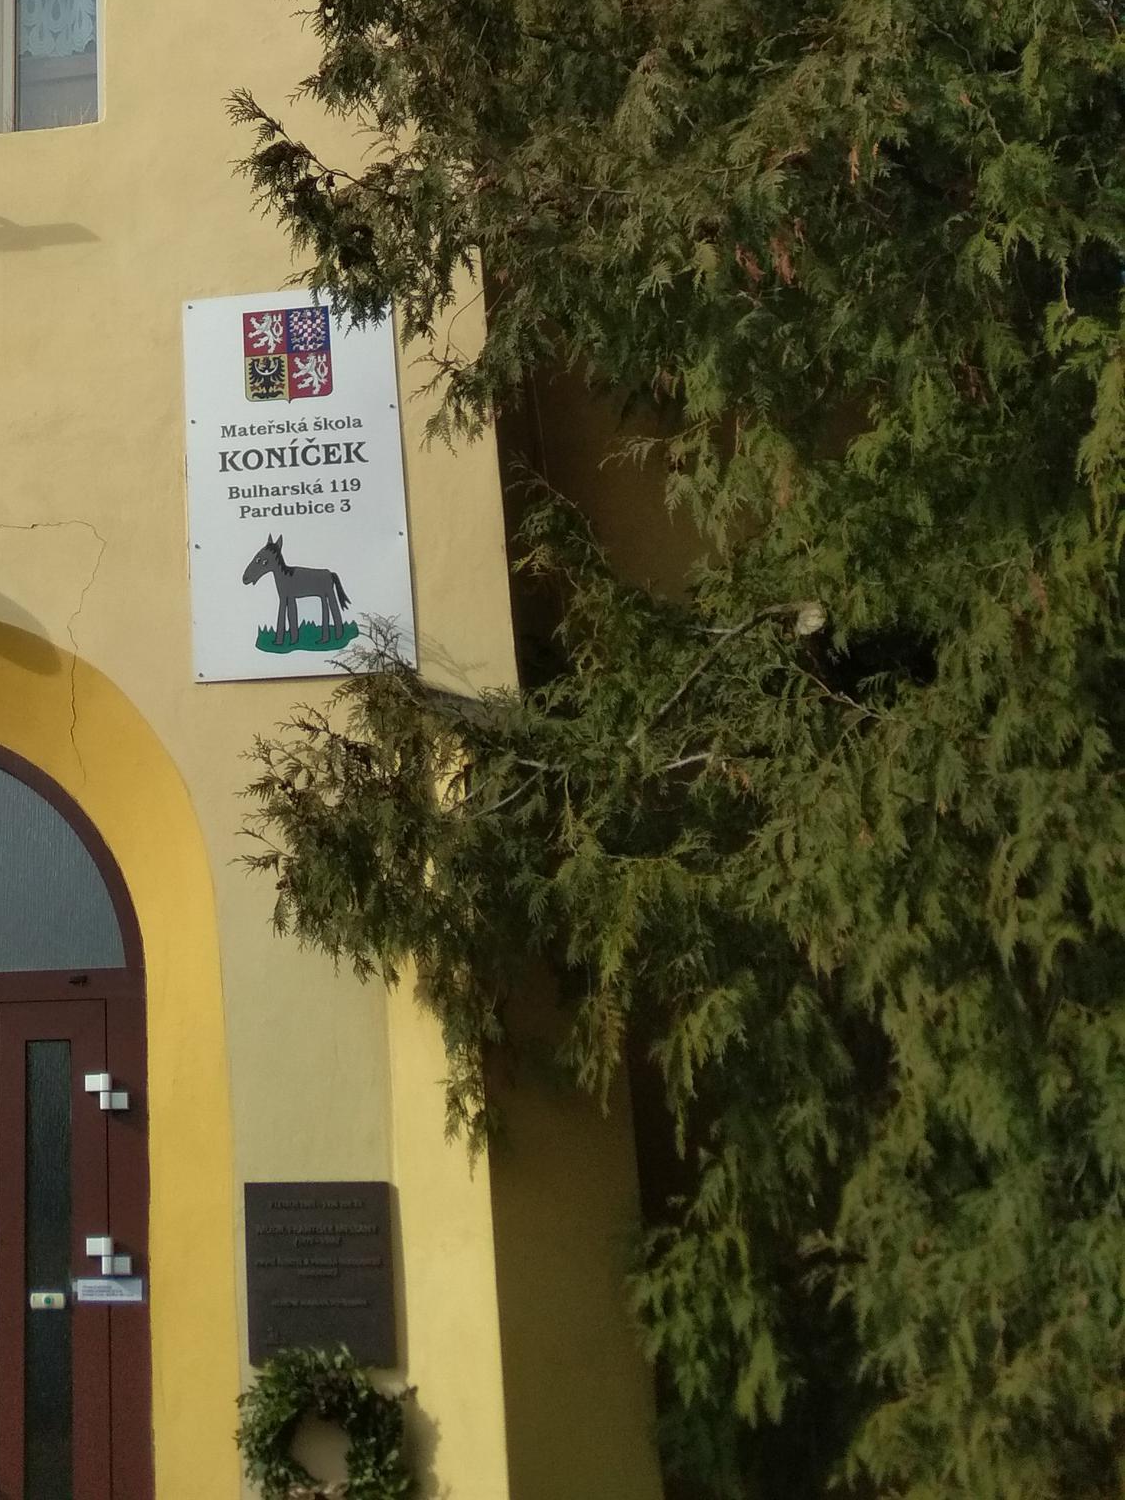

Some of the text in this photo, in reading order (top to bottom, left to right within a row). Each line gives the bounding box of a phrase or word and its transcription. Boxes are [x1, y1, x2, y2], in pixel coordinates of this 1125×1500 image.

[221, 415, 363, 438] Mateřská škola
[218, 437, 369, 472] KONÍČEK
[228, 477, 361, 499] Bulharská 119
[239, 499, 351, 518] Pardubice 3
